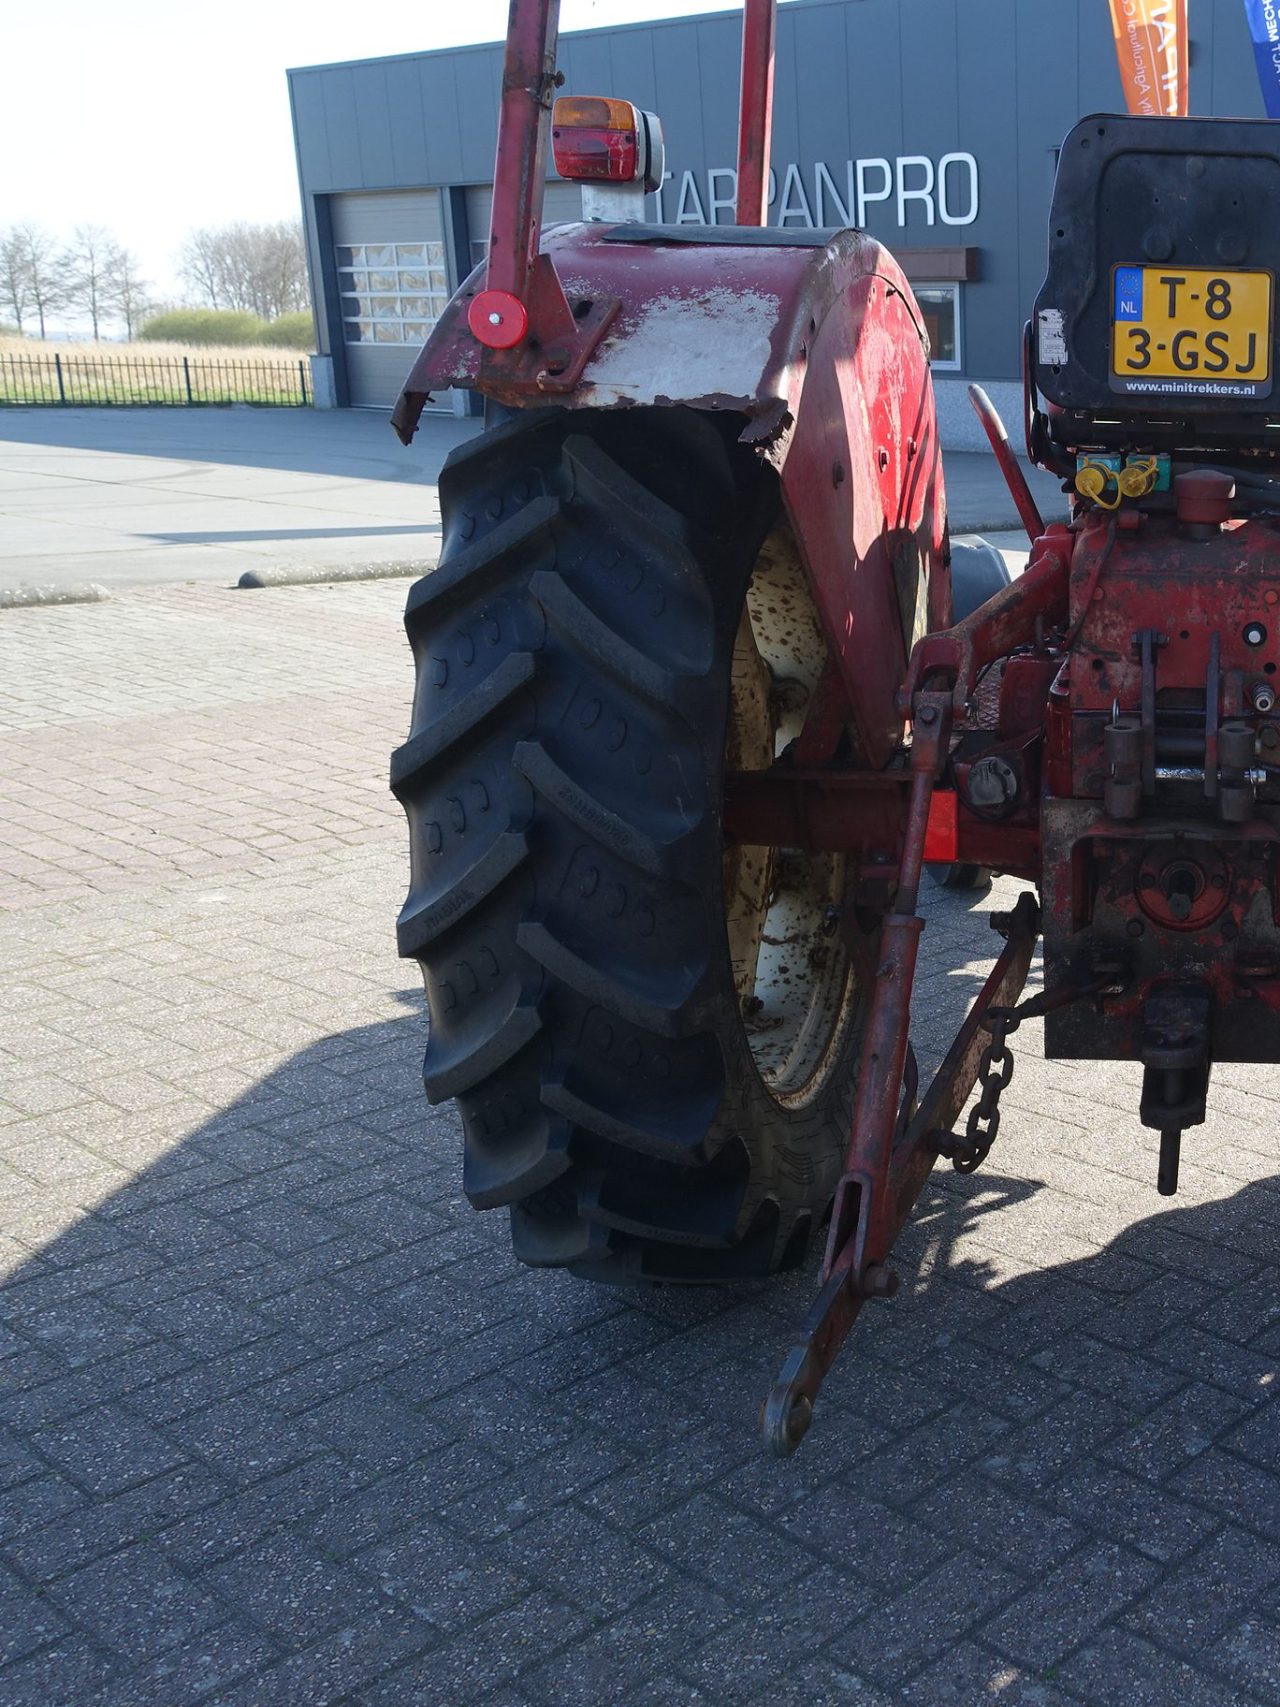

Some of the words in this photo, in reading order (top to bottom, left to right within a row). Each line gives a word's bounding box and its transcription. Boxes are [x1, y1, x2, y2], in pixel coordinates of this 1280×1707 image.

[656, 152, 979, 228] TARANPRO
[1121, 301, 1137, 313] NL
[1160, 276, 1232, 320] T-8
[1126, 328, 1257, 374] 3-GSJ
[1126, 382, 1256, 395] www.minitrekkers.nl
